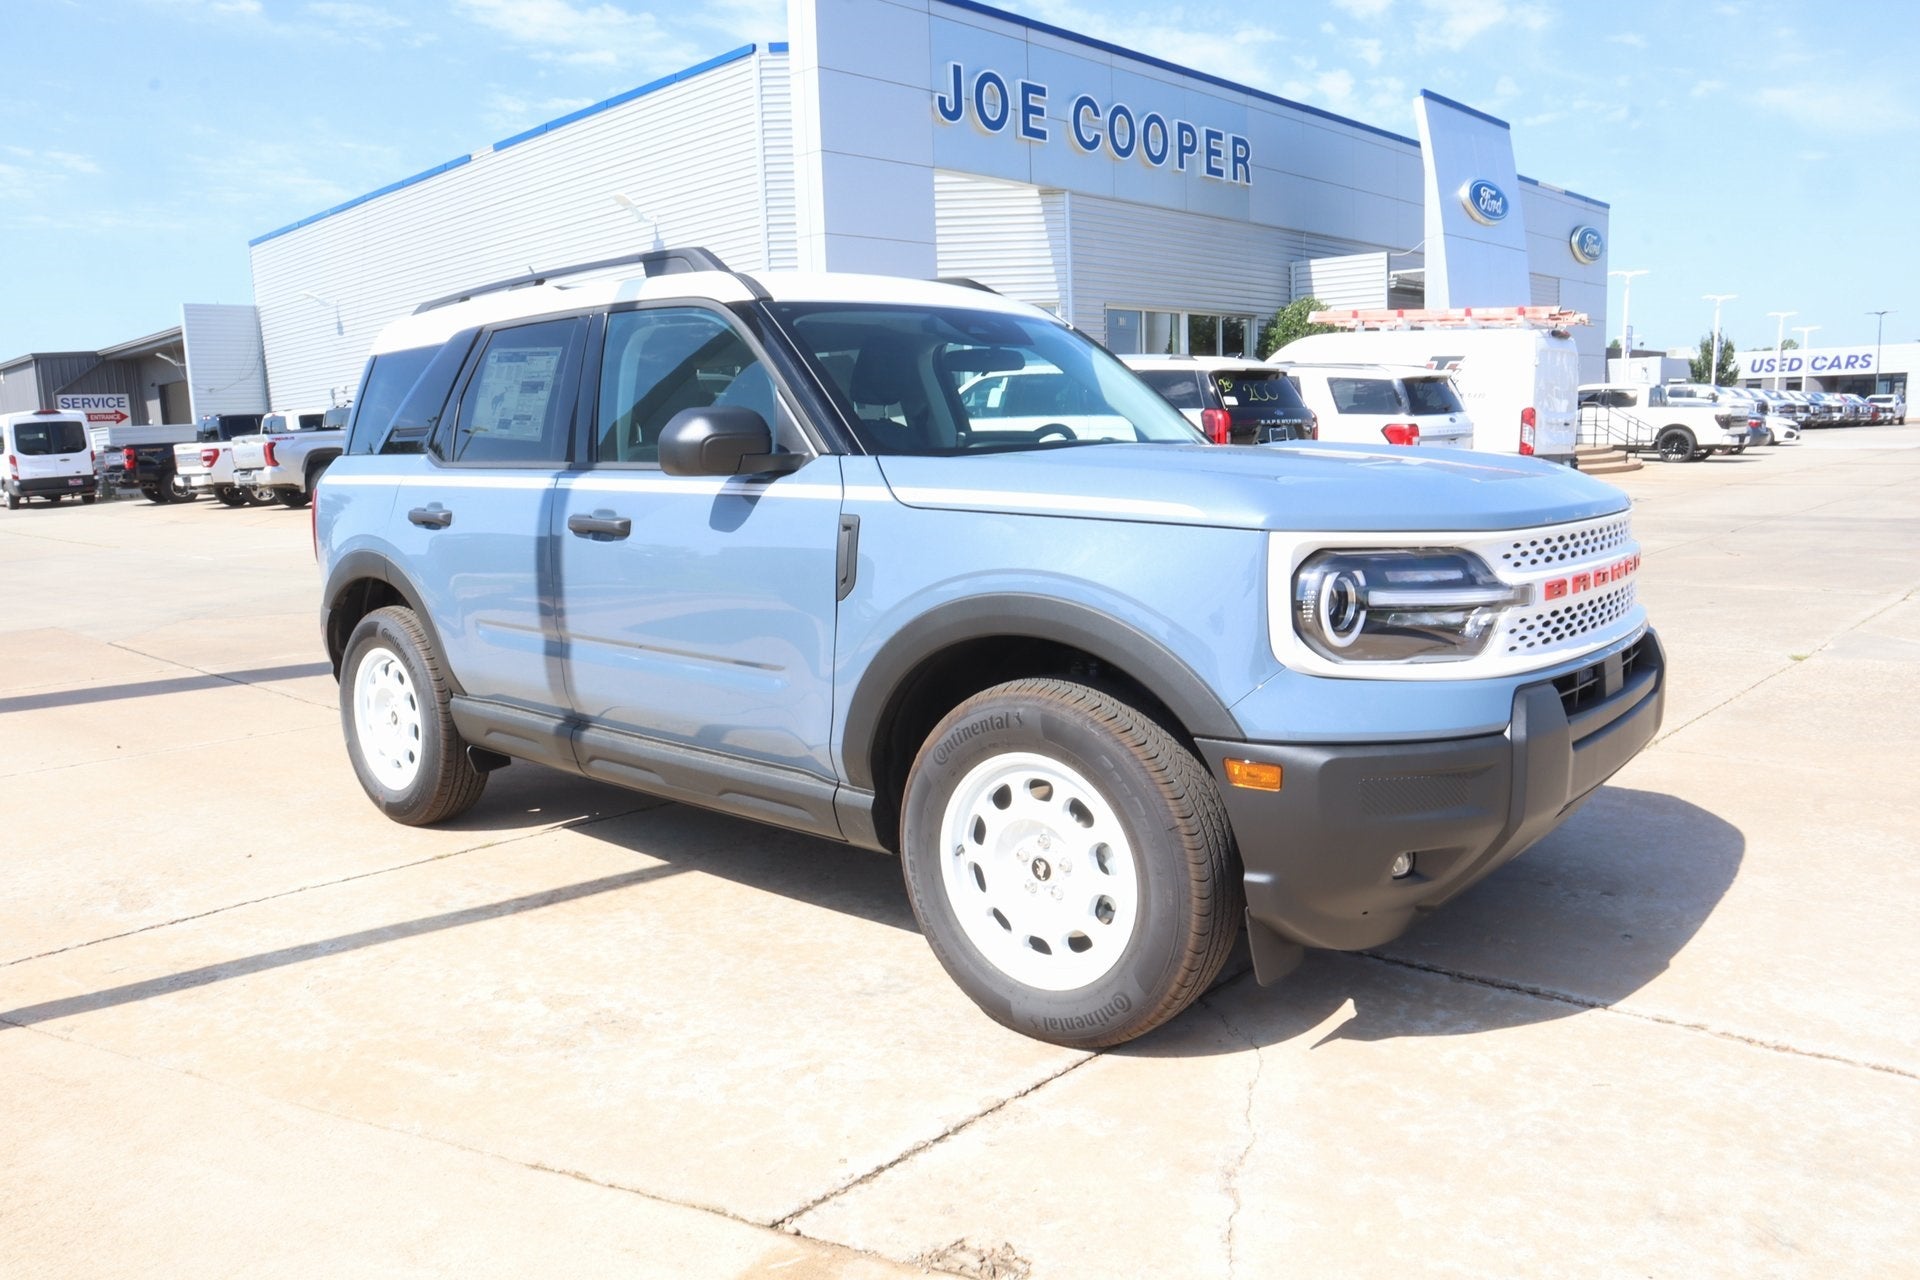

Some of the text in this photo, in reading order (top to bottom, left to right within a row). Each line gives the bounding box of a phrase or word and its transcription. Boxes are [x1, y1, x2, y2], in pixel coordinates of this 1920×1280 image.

[934, 61, 1252, 185] JOE COOPER
[1479, 186, 1503, 214] Ford
[1584, 233, 1602, 255] Ford
[1750, 353, 1873, 373] USED CARS
[60, 396, 127, 409] SERVICE
[89, 413, 121, 421] ENTRANCE
[381, 627, 415, 673] Continental
[932, 711, 1010, 765] Continental
[1043, 991, 1133, 1033] Continental
